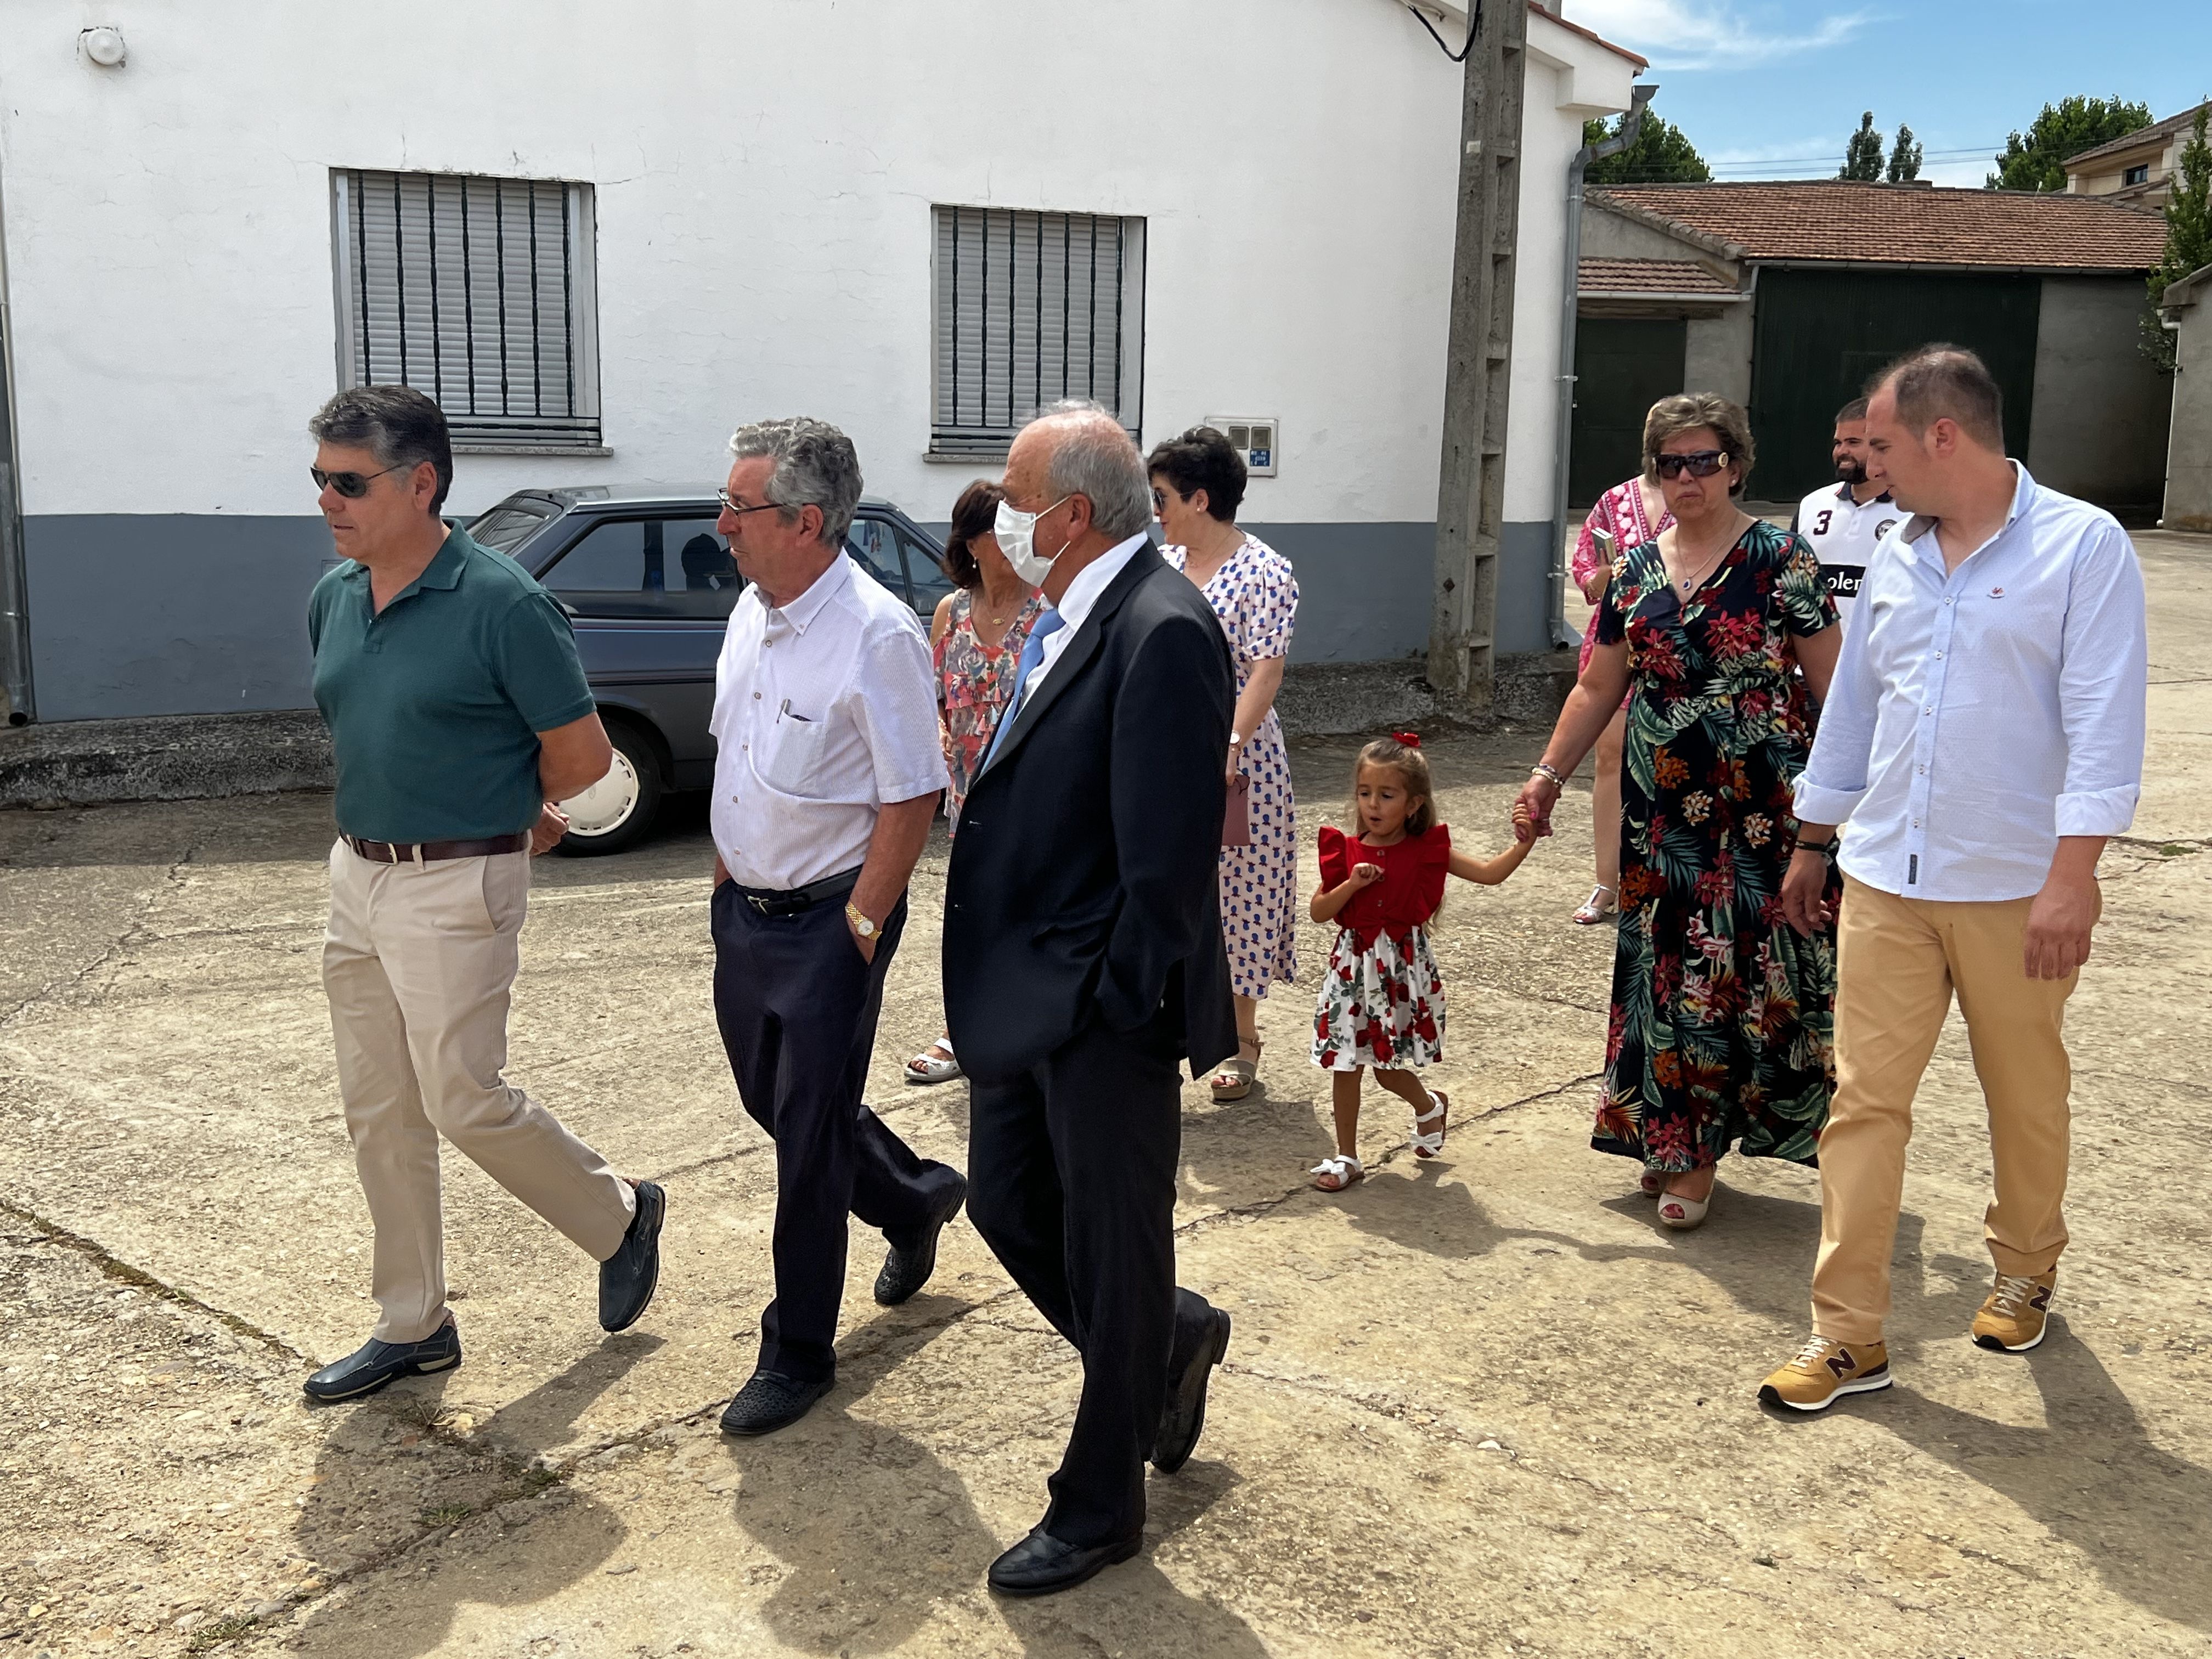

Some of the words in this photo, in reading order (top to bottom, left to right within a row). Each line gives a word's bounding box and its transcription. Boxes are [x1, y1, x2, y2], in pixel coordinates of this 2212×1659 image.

[1813, 510, 1833, 535] 3
[2028, 1285, 2052, 1313] N
[1824, 1347, 1857, 1380] N
